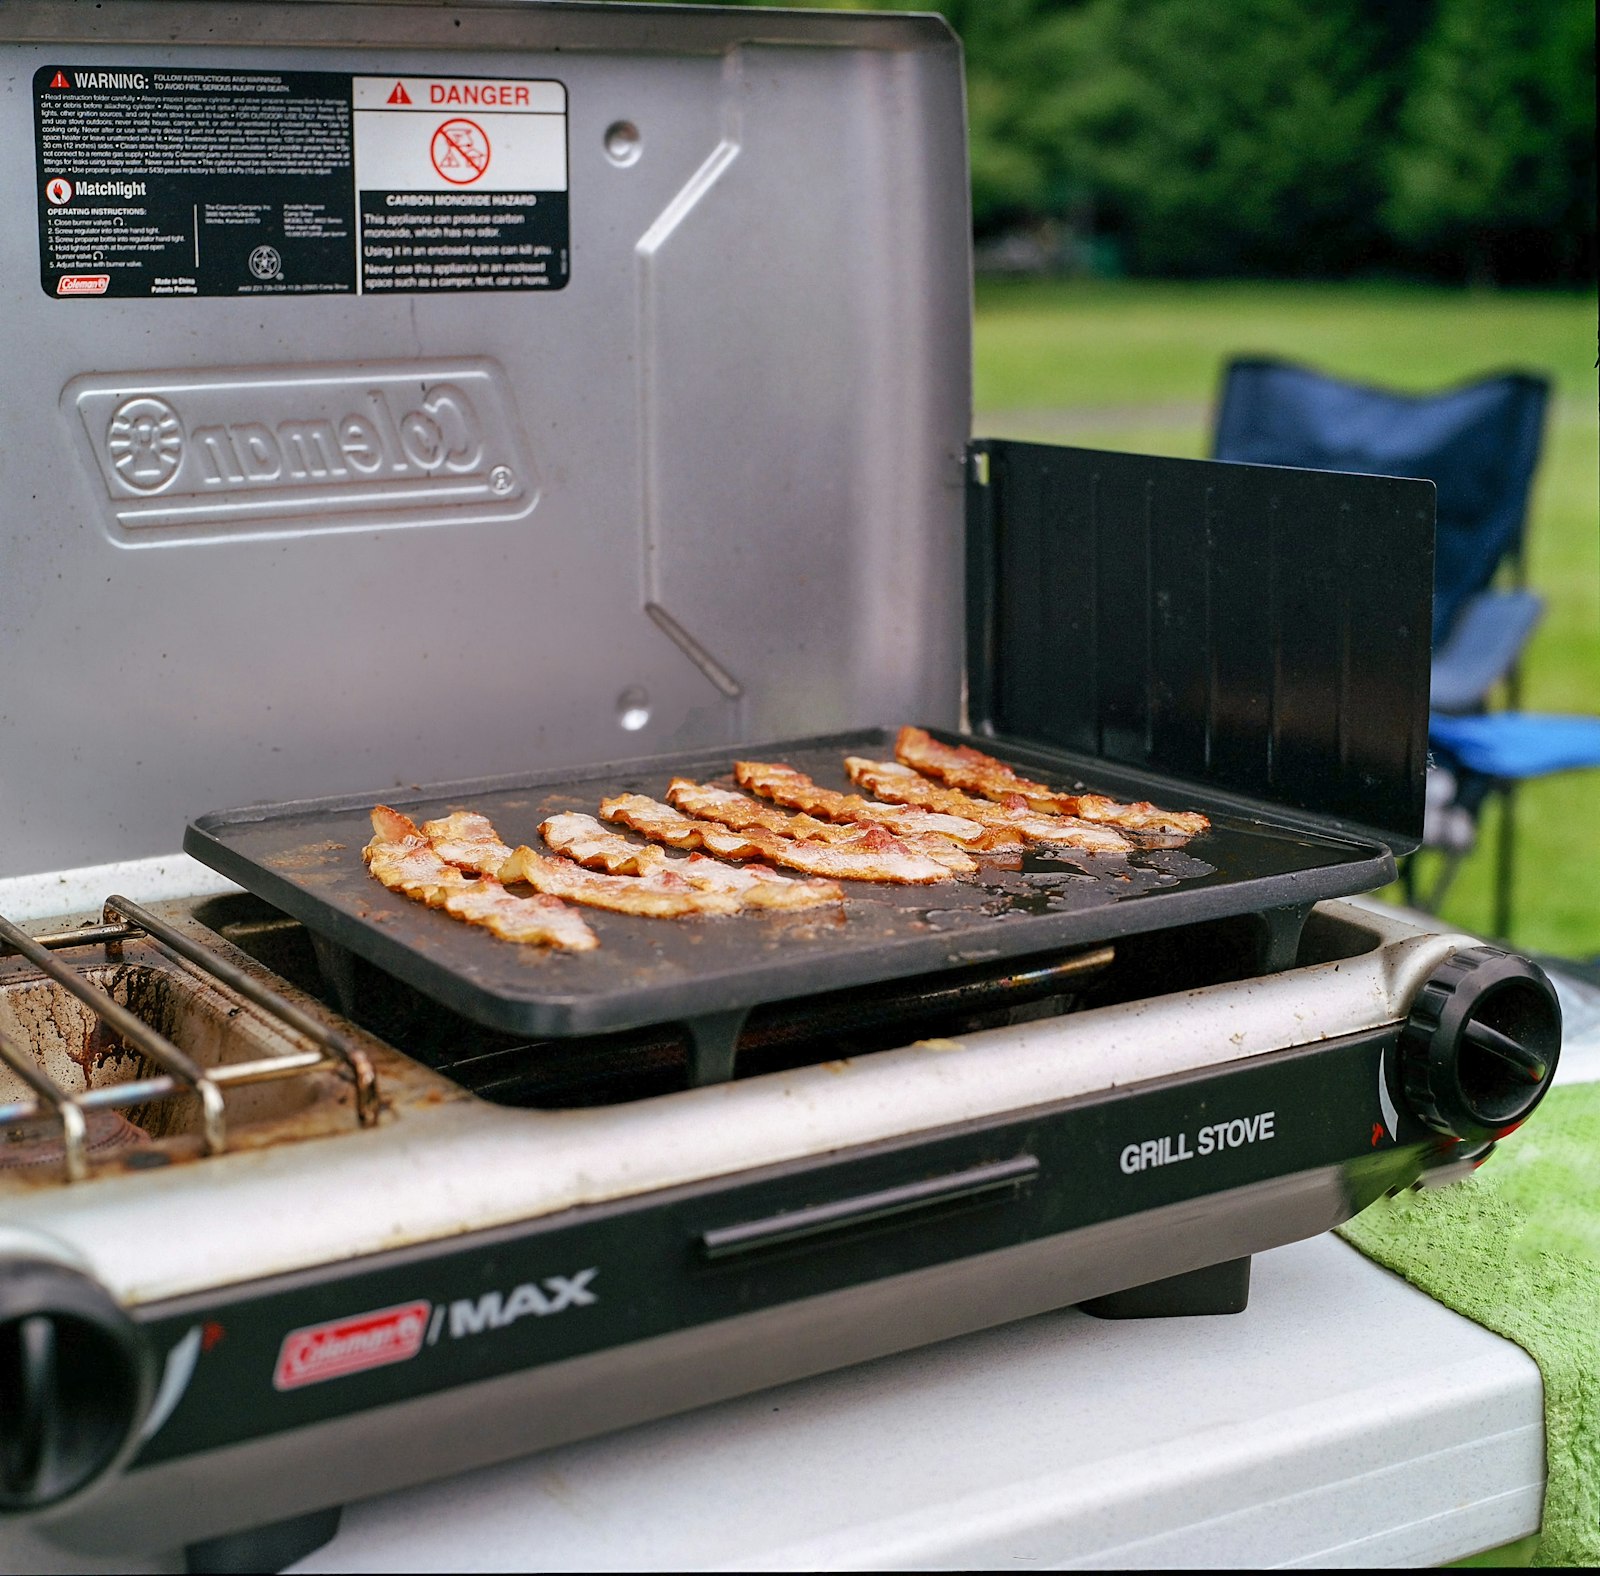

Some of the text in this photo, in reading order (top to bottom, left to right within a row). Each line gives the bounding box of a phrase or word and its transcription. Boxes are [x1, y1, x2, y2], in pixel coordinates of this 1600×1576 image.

[74, 72, 150, 90] WARNING:
[164, 83, 185, 91] AVOID
[430, 85, 530, 105] DANGER
[75, 181, 147, 199] Matchlight
[386, 194, 537, 206] CARBON MONOXIDE HAZARD
[363, 213, 386, 225] This
[385, 213, 433, 226] appliance
[433, 215, 452, 225] can
[363, 245, 394, 258] Using
[61, 278, 98, 290] Coleman
[1119, 1111, 1276, 1175] GRILL STOVE
[450, 1266, 599, 1338] MAX
